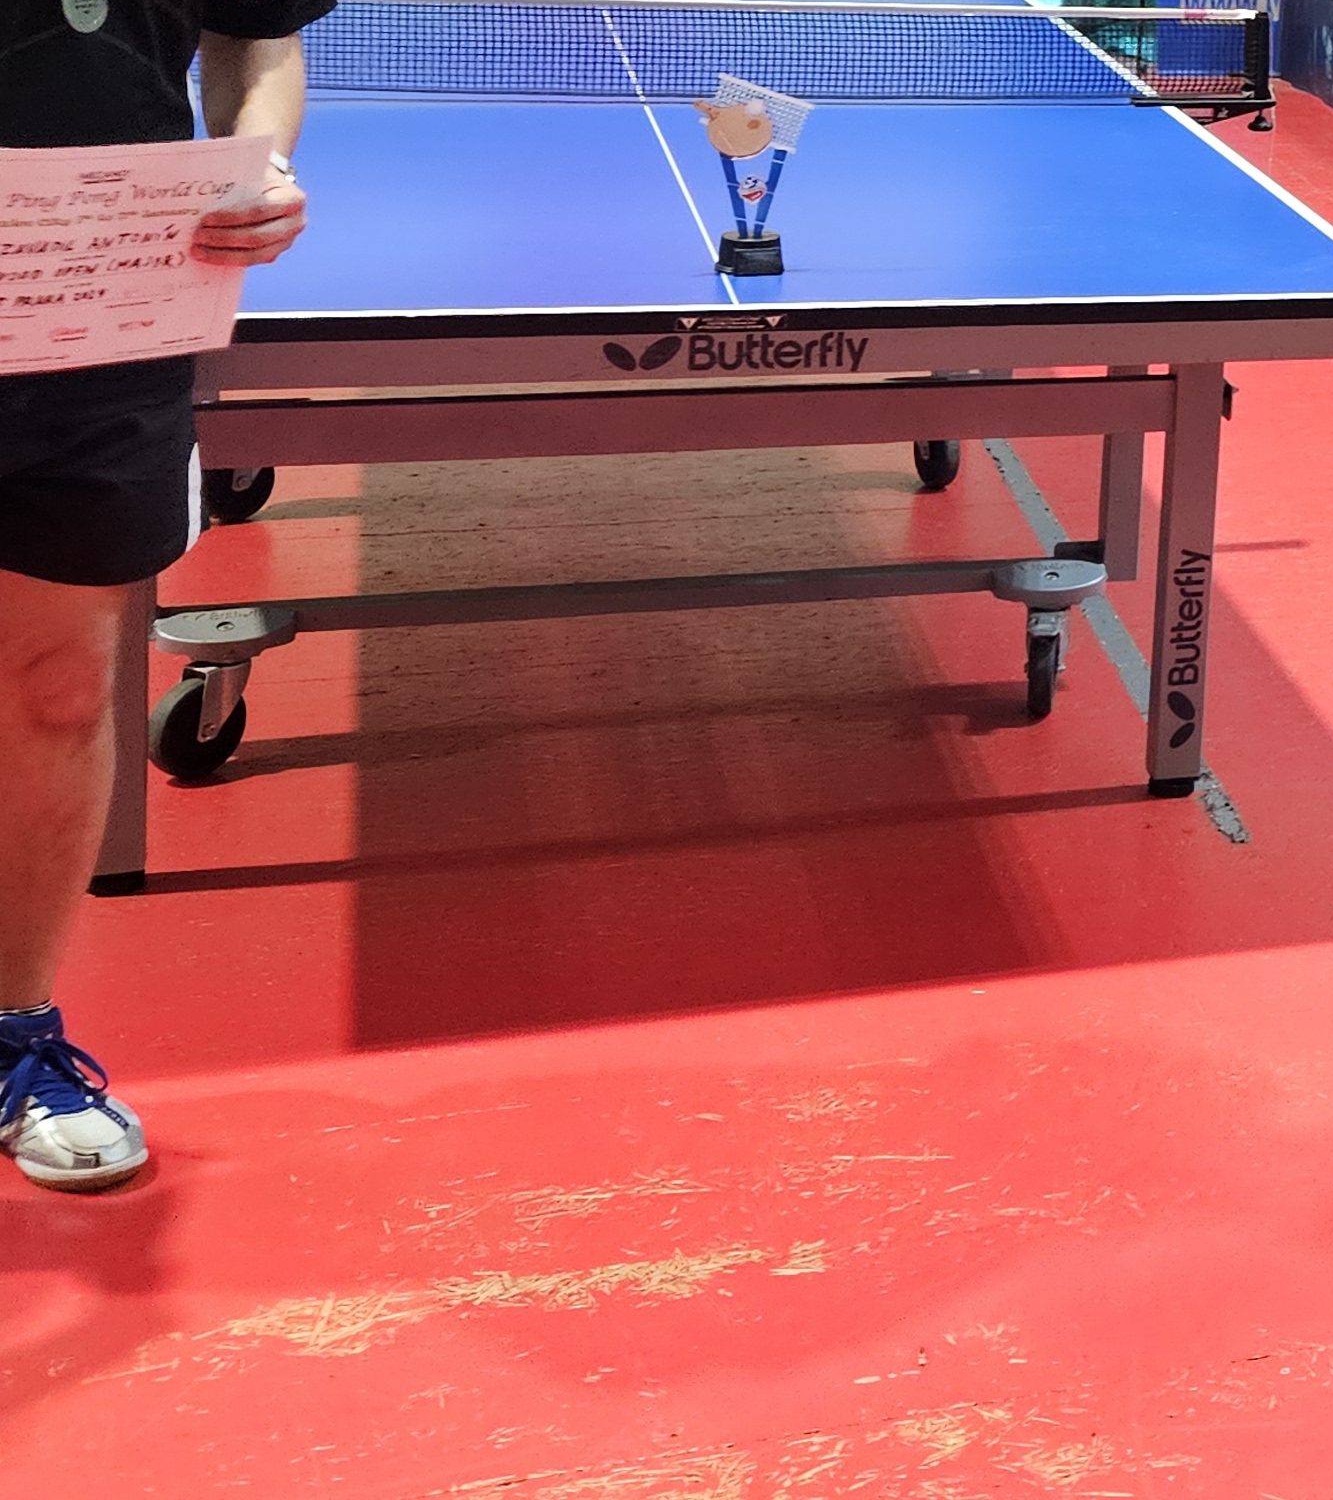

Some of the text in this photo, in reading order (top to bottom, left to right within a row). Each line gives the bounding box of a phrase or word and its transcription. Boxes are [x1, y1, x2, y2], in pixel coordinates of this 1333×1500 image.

[130, 180, 194, 201] World
[196, 179, 237, 200] Cup
[687, 331, 870, 373] Butterfly
[1167, 548, 1213, 687] Butterfly
